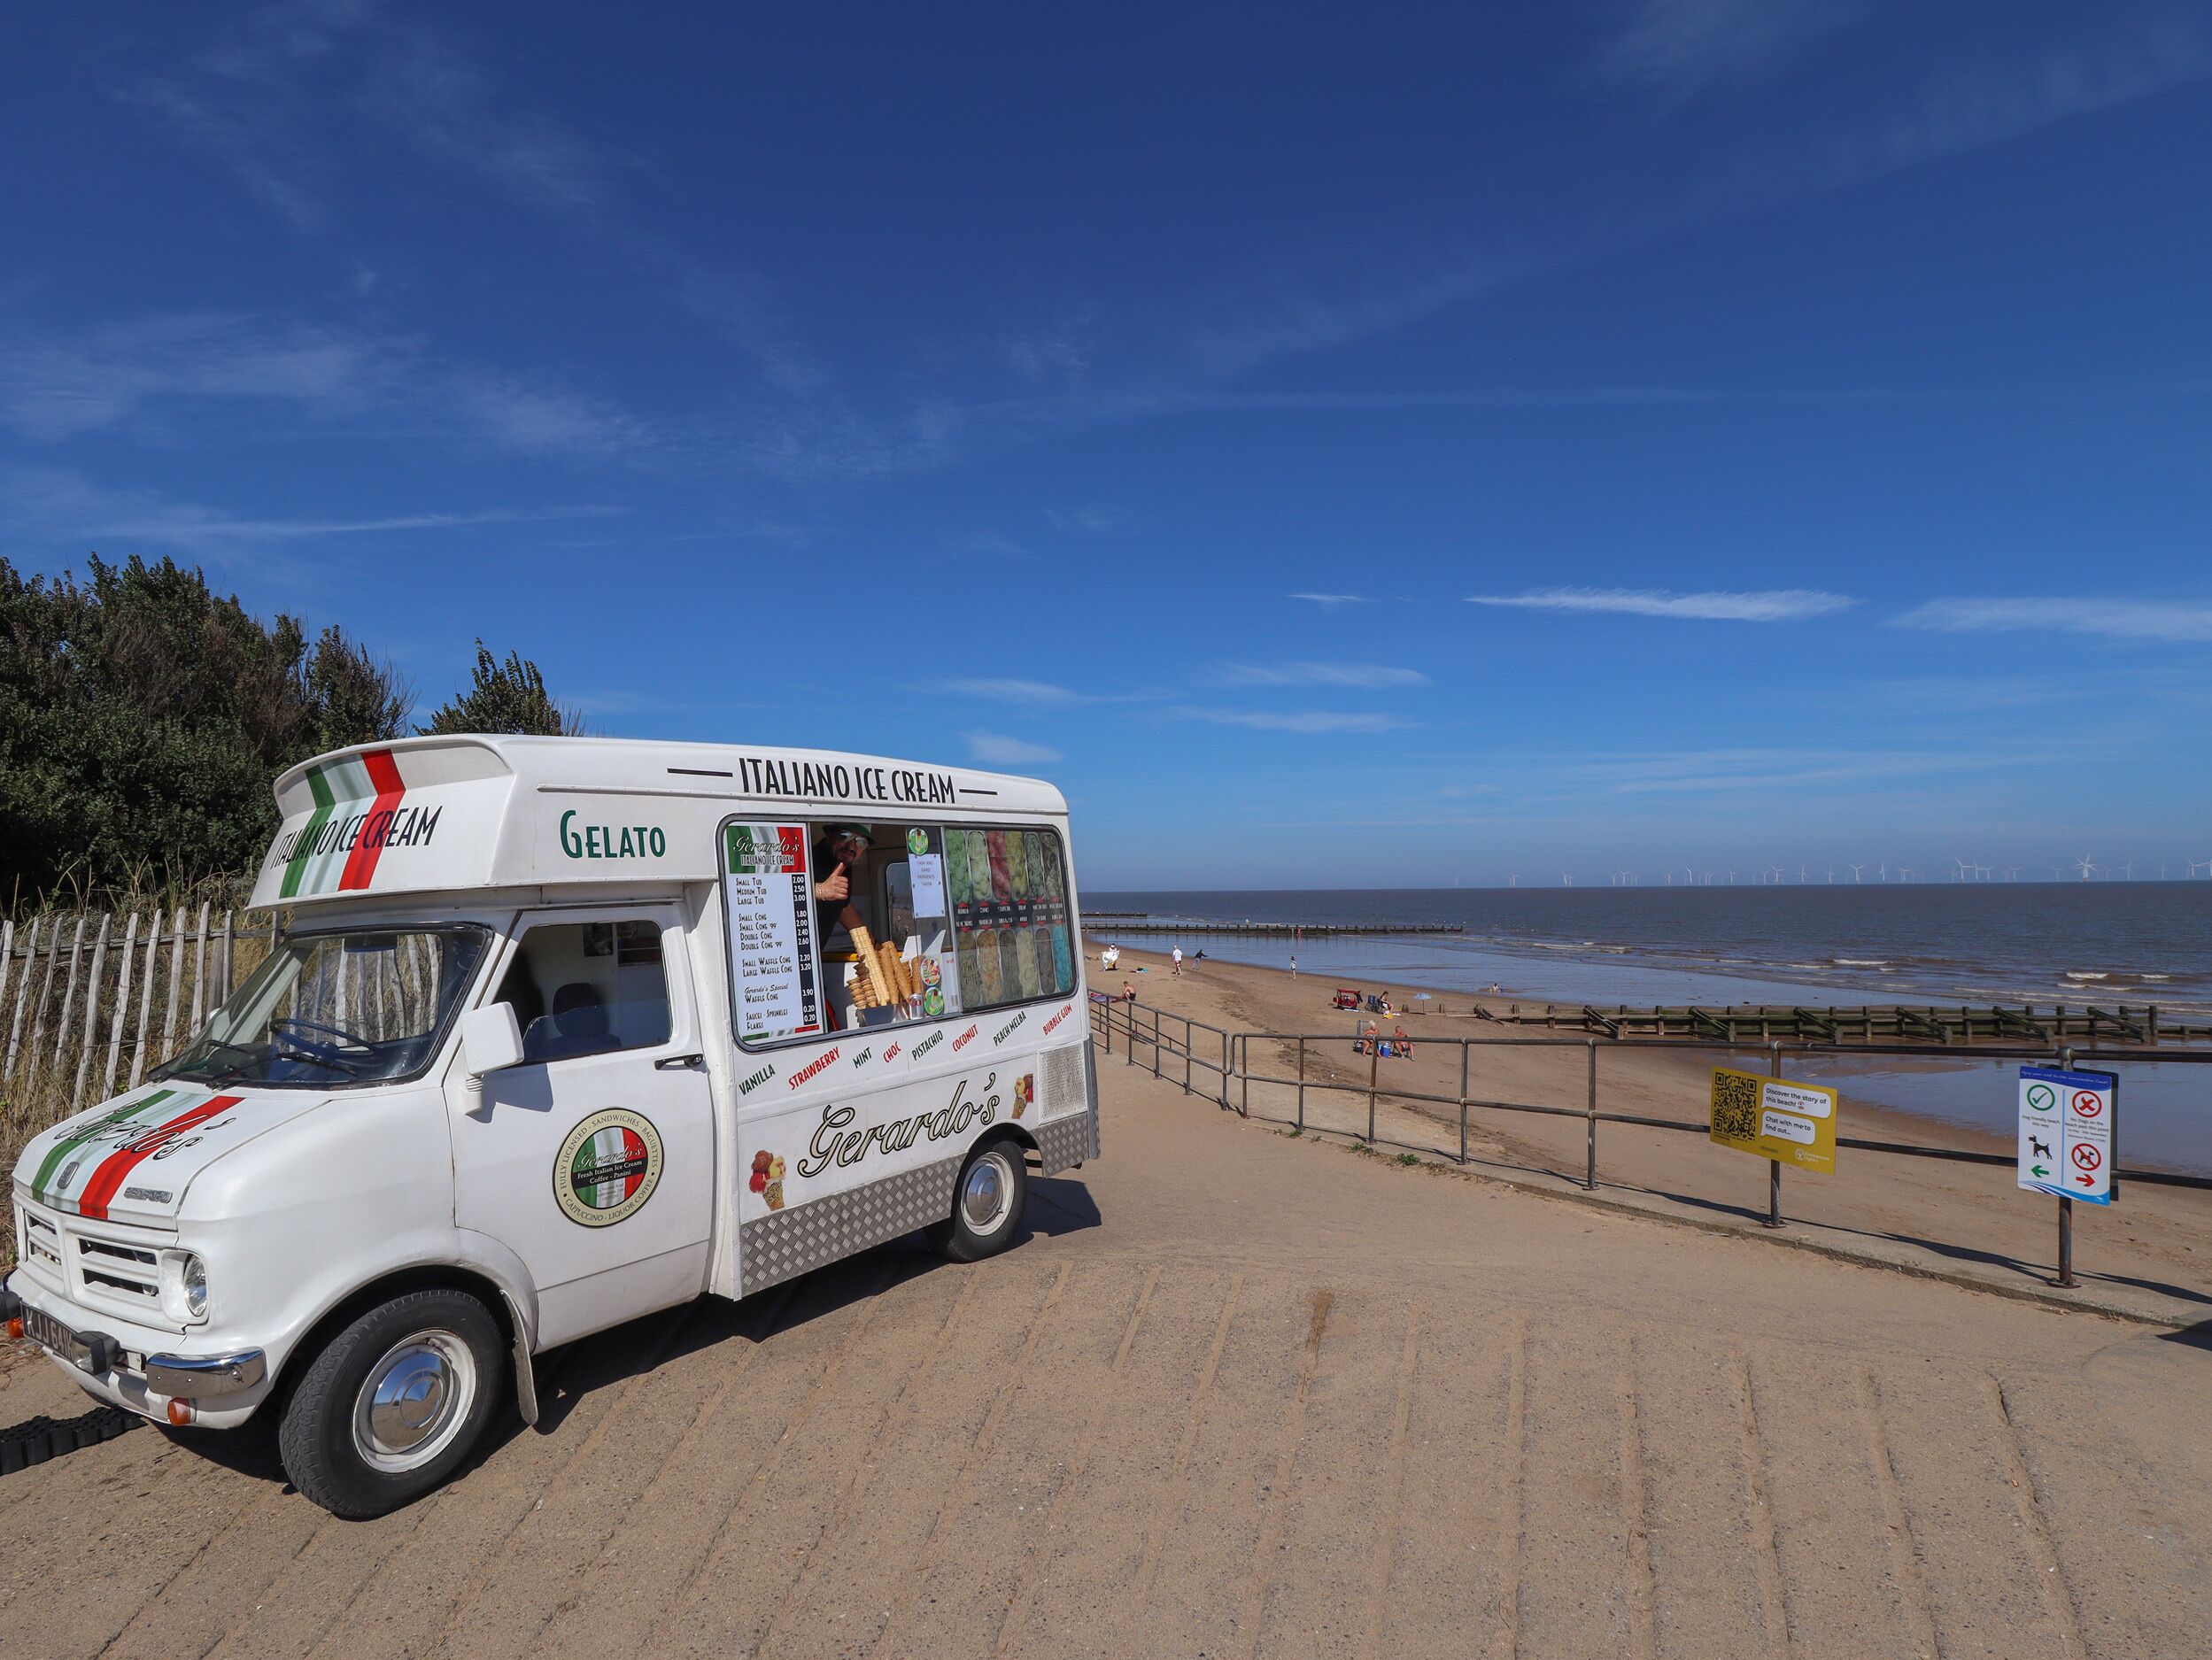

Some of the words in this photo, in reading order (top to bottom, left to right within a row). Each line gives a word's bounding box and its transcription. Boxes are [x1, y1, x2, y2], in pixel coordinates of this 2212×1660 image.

[739, 758, 850, 798] ITALIANO
[855, 767, 888, 800] ICE
[892, 770, 955, 804] CREAM
[271, 820, 338, 869] ITALIANO
[331, 814, 369, 853] ICE
[363, 806, 443, 848] CREAM
[560, 810, 667, 859] GELATO
[733, 836, 800, 852] Gerardo's
[741, 854, 765, 866] ITALIANO
[767, 855, 776, 866] ICE
[777, 855, 793, 866] CREAM
[770, 984, 789, 992] Special
[994, 1025, 1011, 1046] PEACH
[1009, 1011, 1027, 1031] MELBA
[1042, 1015, 1062, 1035] BUBBLE
[1061, 1004, 1072, 1019] GUM
[883, 1041, 901, 1063] CHOC
[912, 1030, 943, 1061] PISTACHIO
[952, 1023, 978, 1052] COCONUT
[788, 1046, 840, 1091] STRAWBERRY
[853, 1046, 872, 1069] MINT
[739, 1064, 776, 1095] VANILLA
[1767, 1088, 1790, 1097] Discover
[797, 1072, 1001, 1177] Gerardo's
[564, 1127, 588, 1162] LICENSED
[592, 1115, 639, 1127] SANDWICHES
[642, 1127, 658, 1168] BAGUETTES
[577, 1142, 642, 1168] Gerardo's
[566, 1198, 603, 1222] CAPPUCCINO
[608, 1202, 635, 1220] LIQUOR
[635, 1178, 653, 1203] COFFEE
